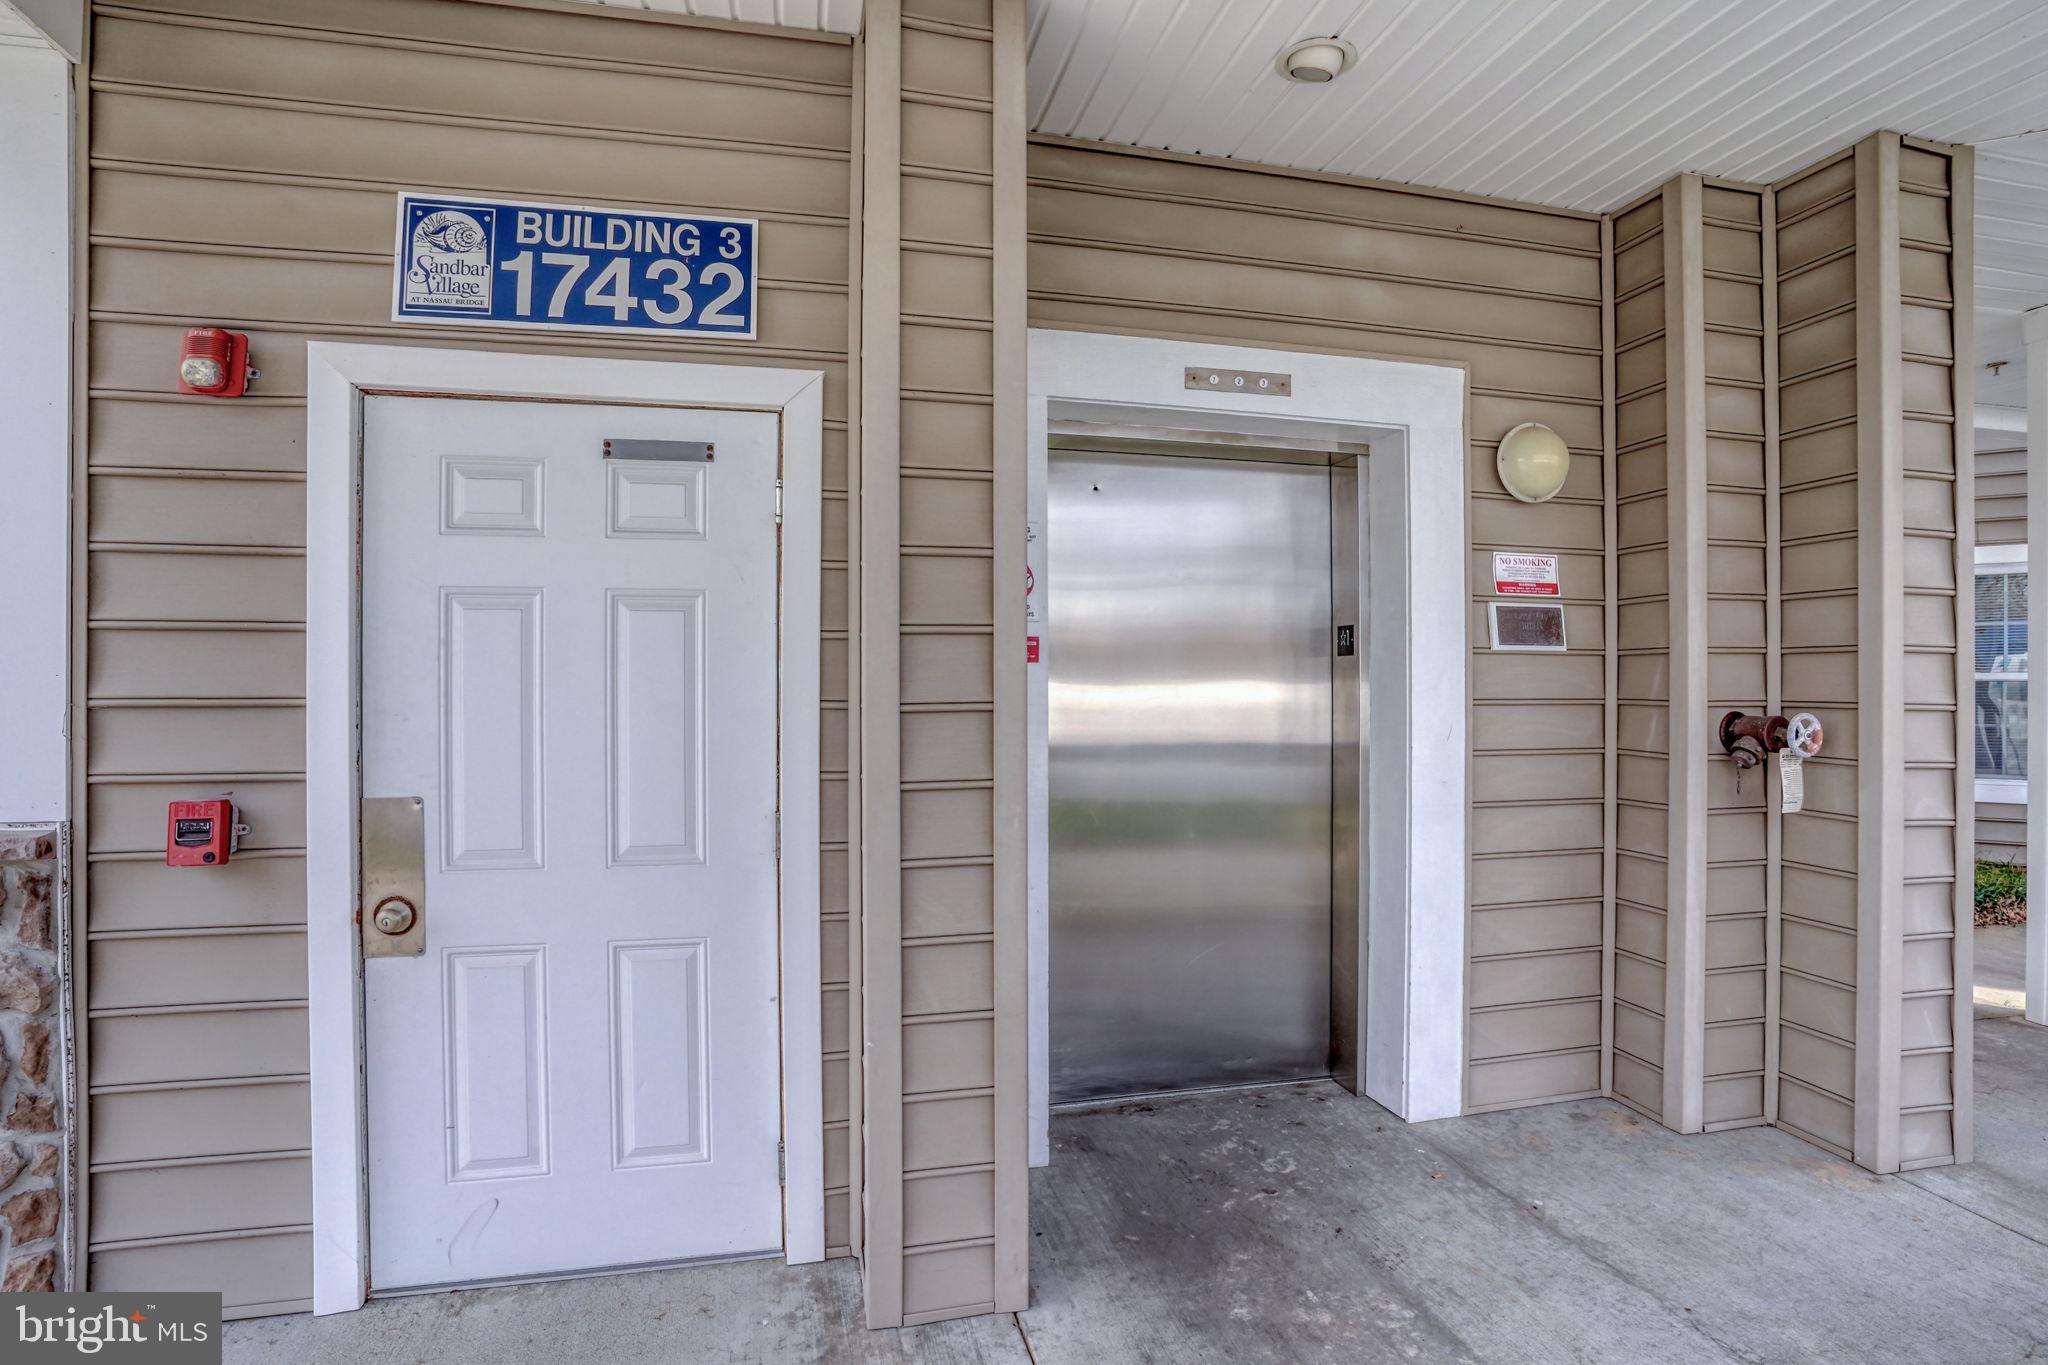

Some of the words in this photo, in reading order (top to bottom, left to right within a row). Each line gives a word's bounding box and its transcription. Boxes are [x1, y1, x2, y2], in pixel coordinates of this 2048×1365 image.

[516, 211, 701, 257] BUILDING
[718, 227, 743, 259] 3
[409, 255, 489, 284] Sandbar
[424, 273, 480, 298] Village
[501, 250, 745, 327] 17432
[1499, 557, 1511, 565] NO
[1513, 558, 1552, 567] SMOKING
[174, 803, 216, 818] FIRE
